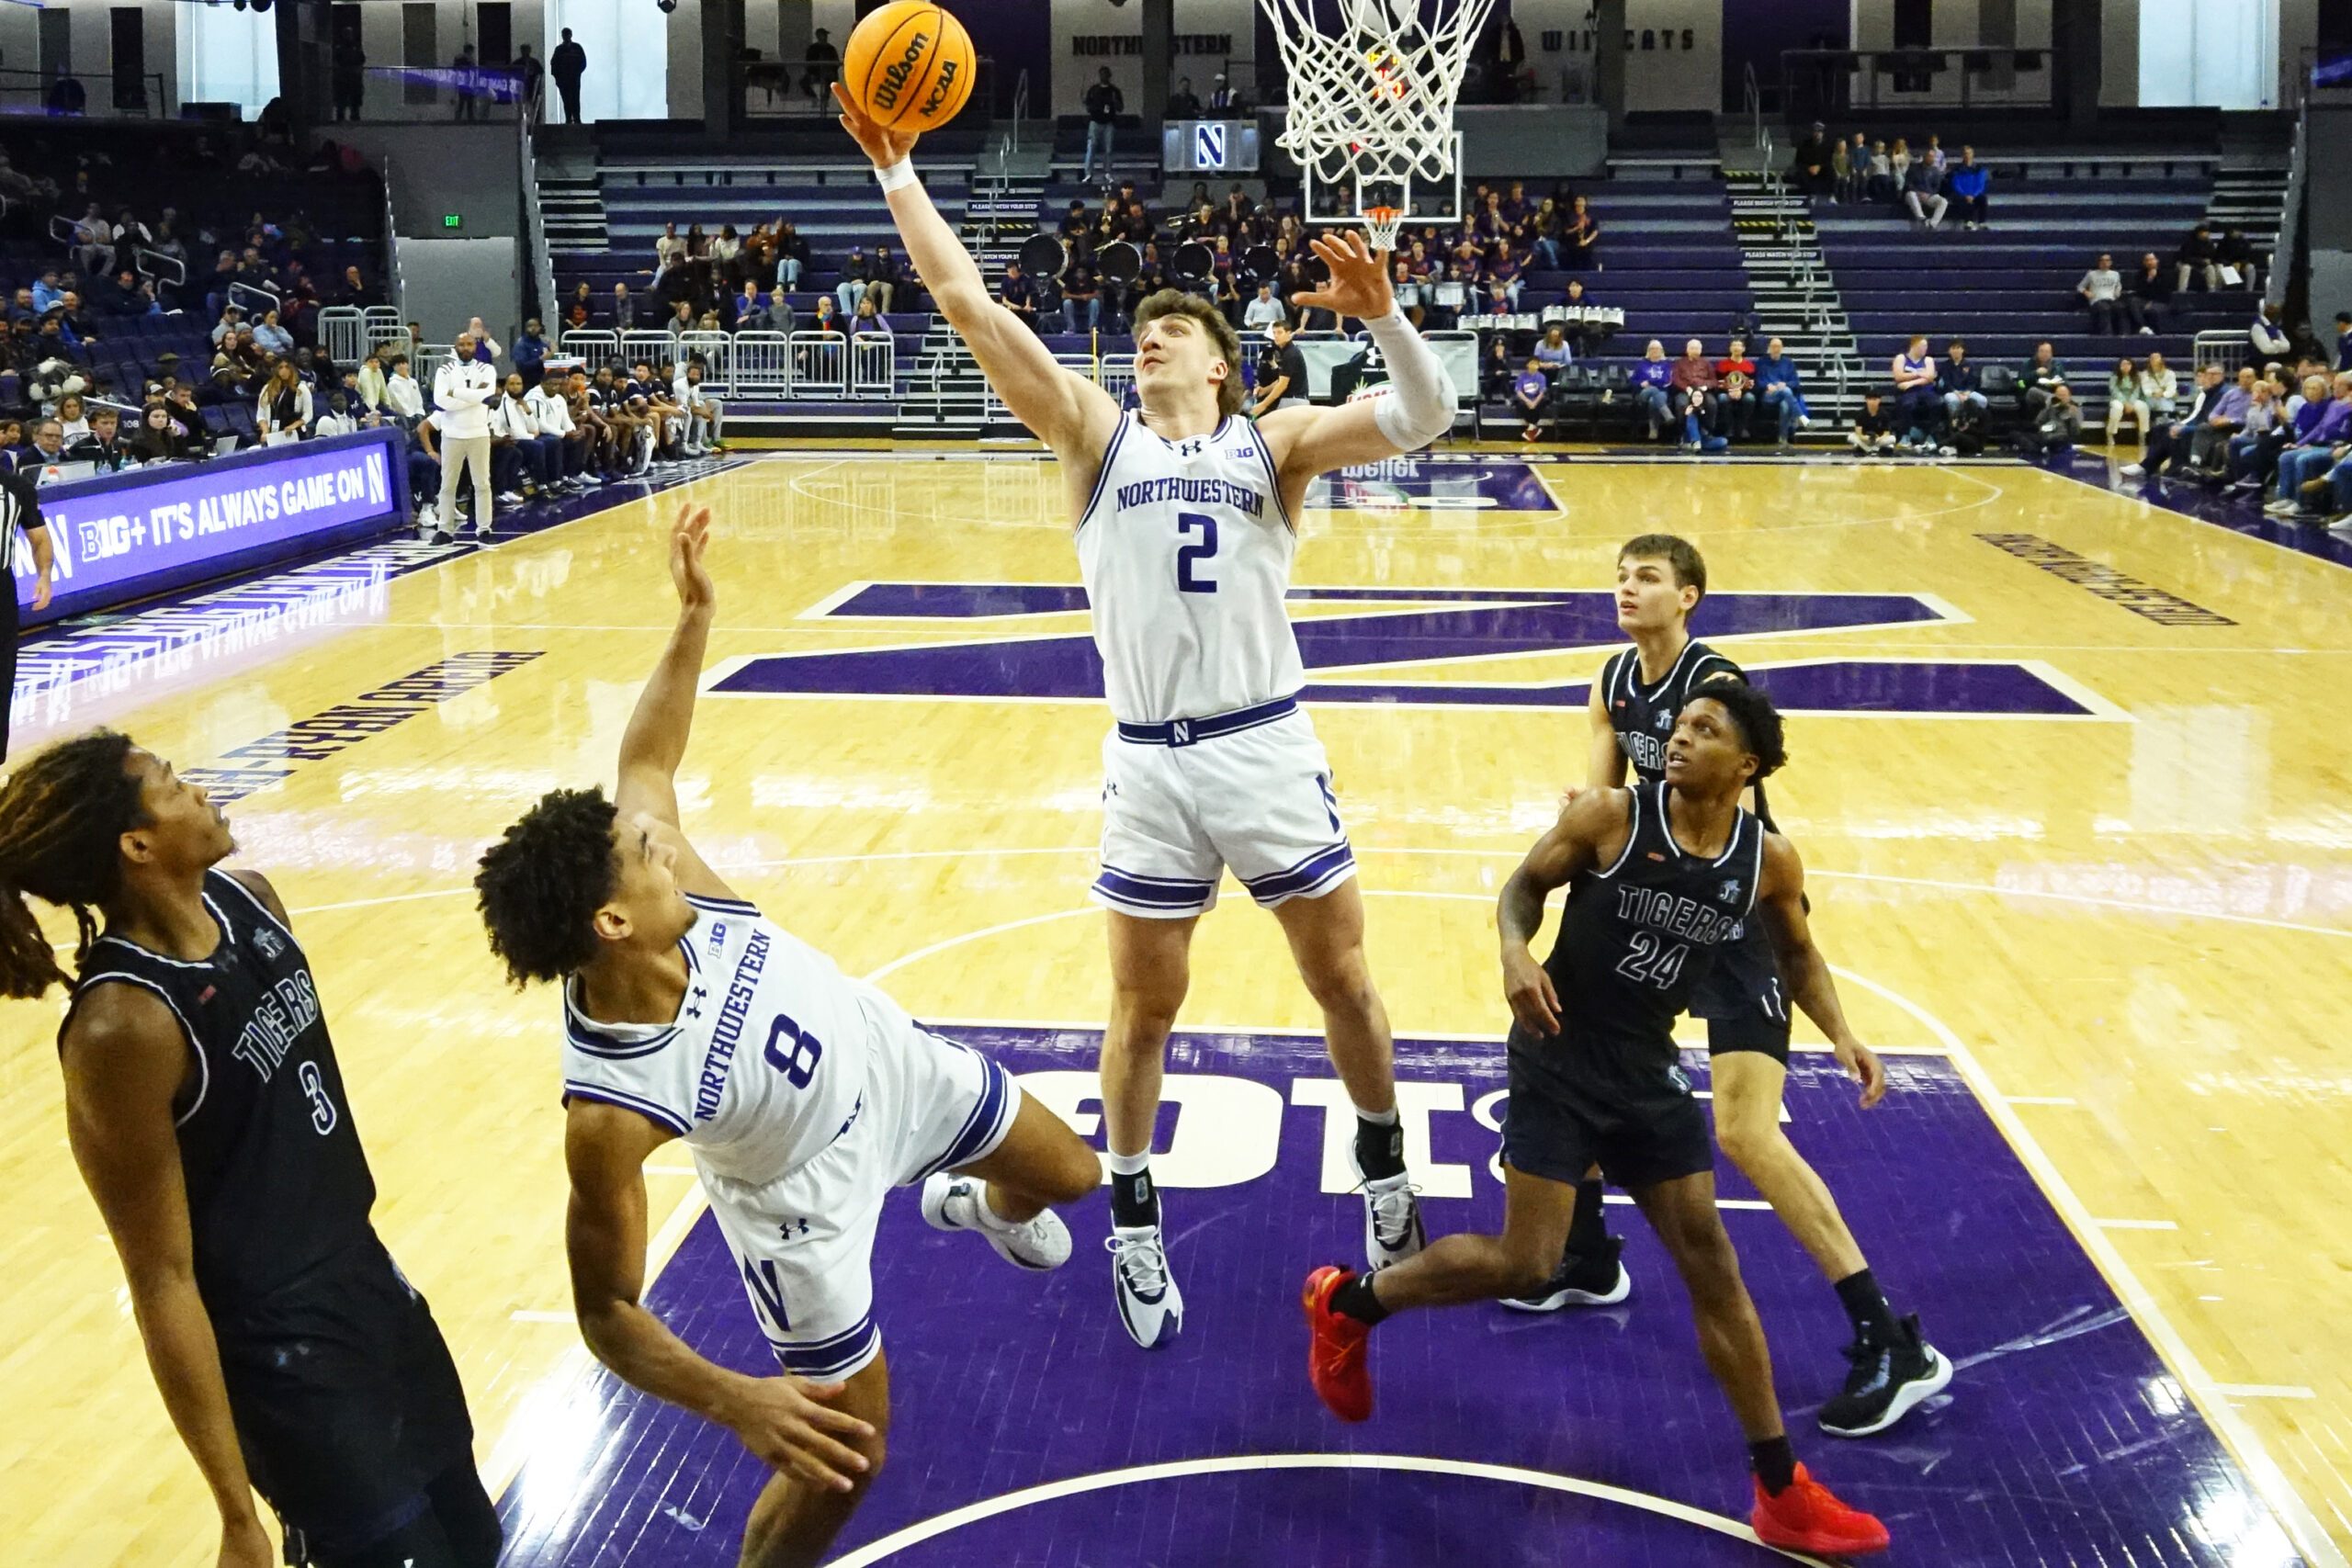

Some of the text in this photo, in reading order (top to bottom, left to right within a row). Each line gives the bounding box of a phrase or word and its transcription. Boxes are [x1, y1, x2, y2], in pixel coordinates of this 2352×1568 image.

[1072, 34, 1232, 56] NORTHSTERN
[1542, 28, 1694, 52] WILCATS
[873, 31, 930, 110] Wilson
[920, 60, 957, 118] NCAA
[1196, 124, 1226, 167] N
[445, 215, 459, 226] EXIT
[150, 502, 195, 547] IT'S
[198, 486, 277, 536] ALWAYS
[281, 472, 337, 516] GAME
[339, 467, 365, 502] ON
[367, 452, 386, 505] N
[1116, 476, 1265, 520] NORTHWESTERN
[1177, 512, 1218, 593] 2
[1172, 720, 1190, 743] N
[1617, 884, 1735, 945] TIGERS
[1615, 930, 1690, 990] 24
[232, 968, 319, 1084] TIGERS
[694, 928, 772, 1122] NORTHWESTERN
[763, 1013, 822, 1090] 8
[299, 1060, 337, 1135] 3
